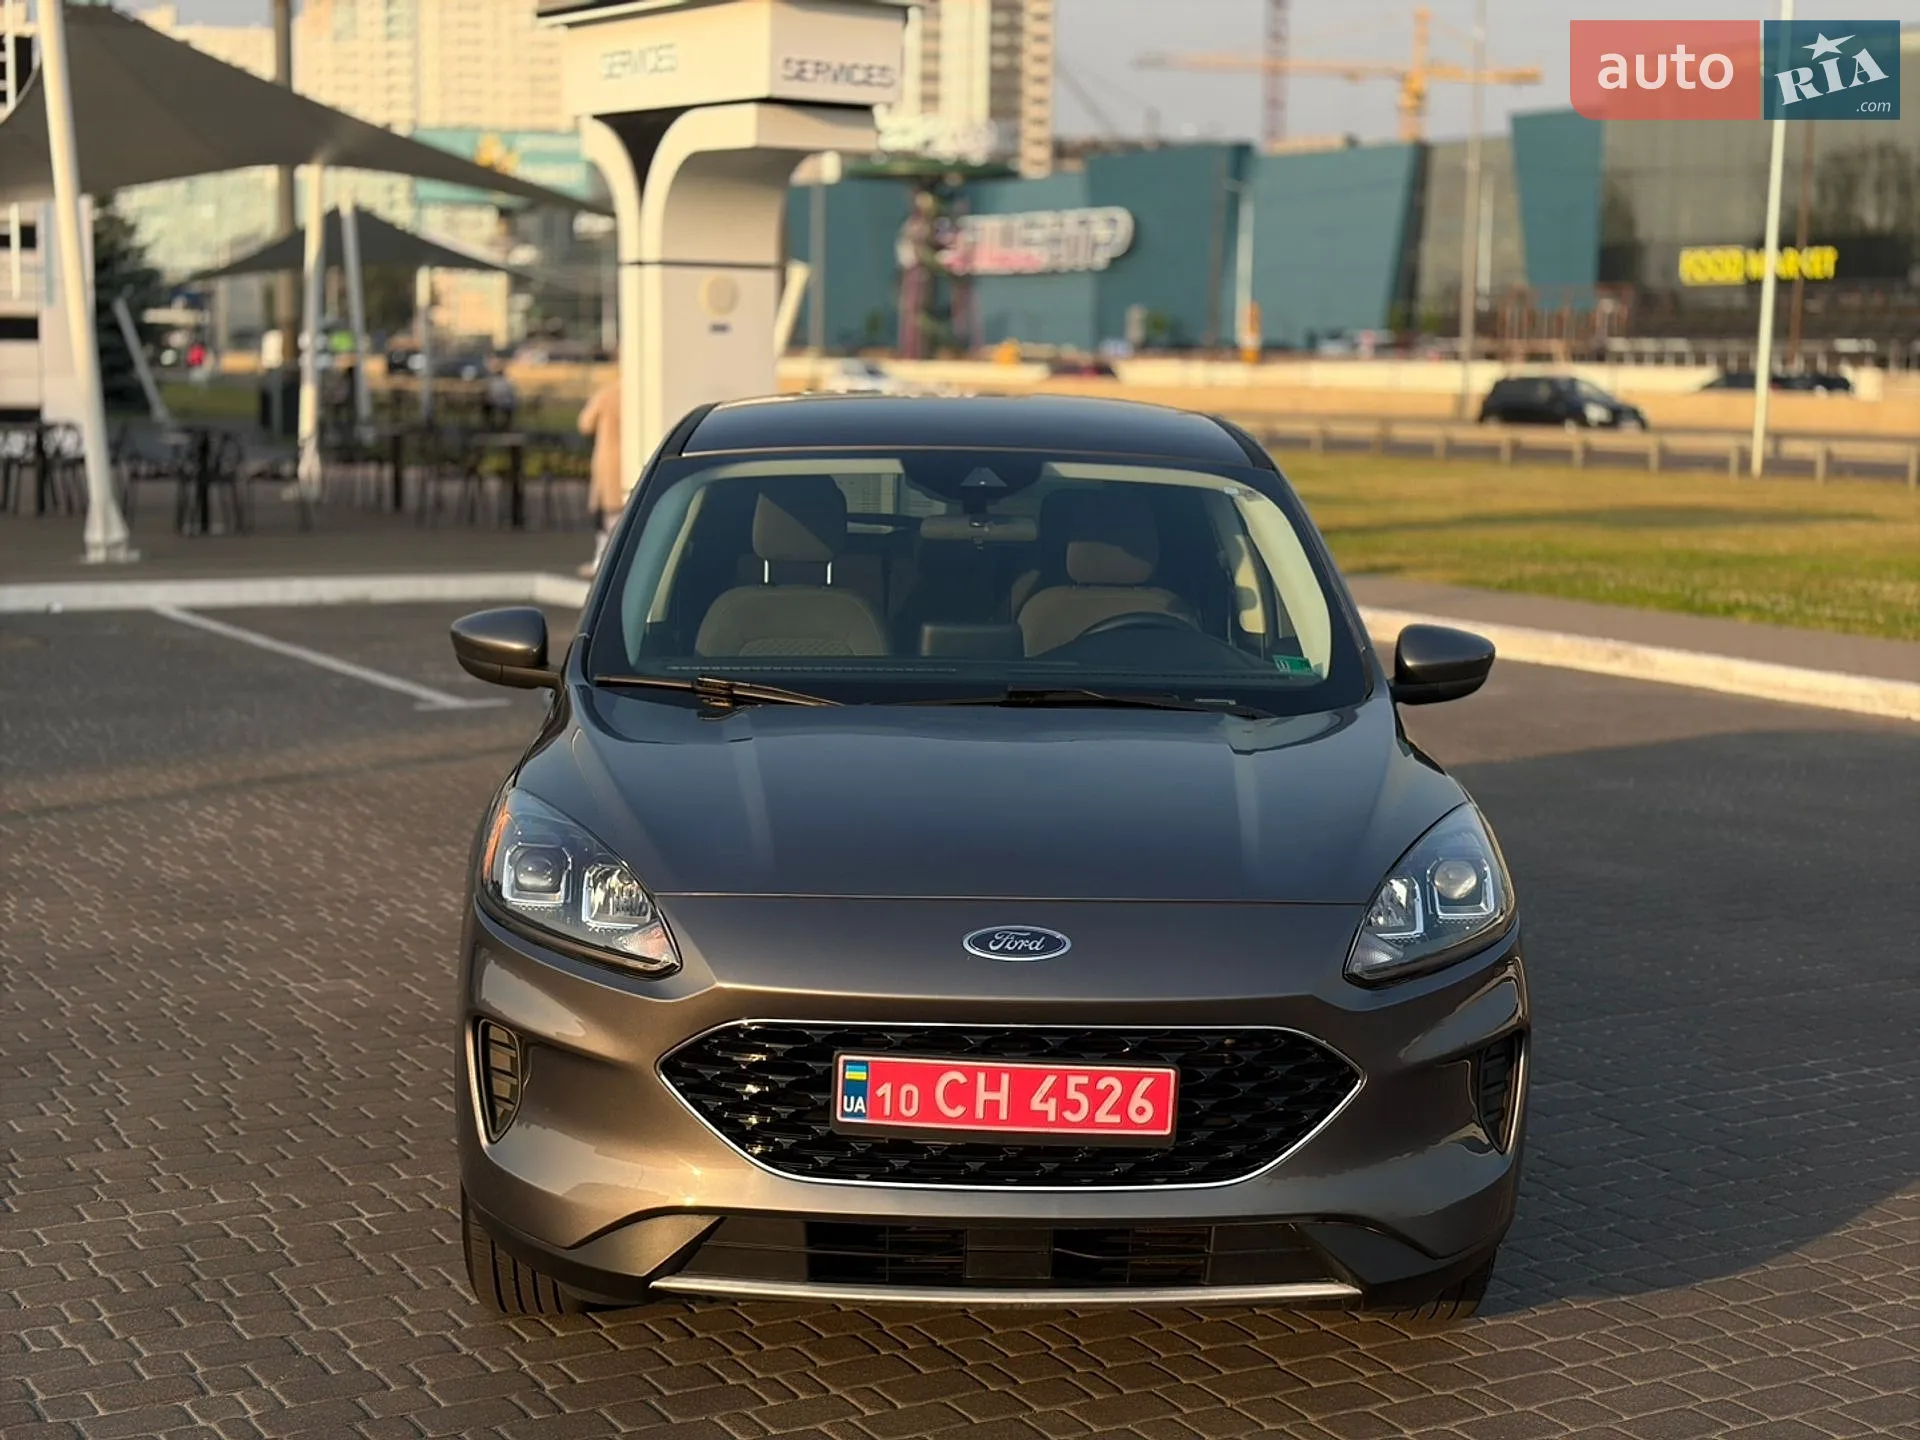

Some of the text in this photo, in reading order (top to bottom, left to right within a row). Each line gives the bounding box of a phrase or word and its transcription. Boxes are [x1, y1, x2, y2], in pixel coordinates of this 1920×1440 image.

[600, 42, 678, 79] SERVICES
[781, 56, 897, 88] SERVICES
[988, 930, 1046, 951] Ford
[843, 1095, 867, 1113] UA
[875, 1070, 1156, 1125] 10 CH 4526
